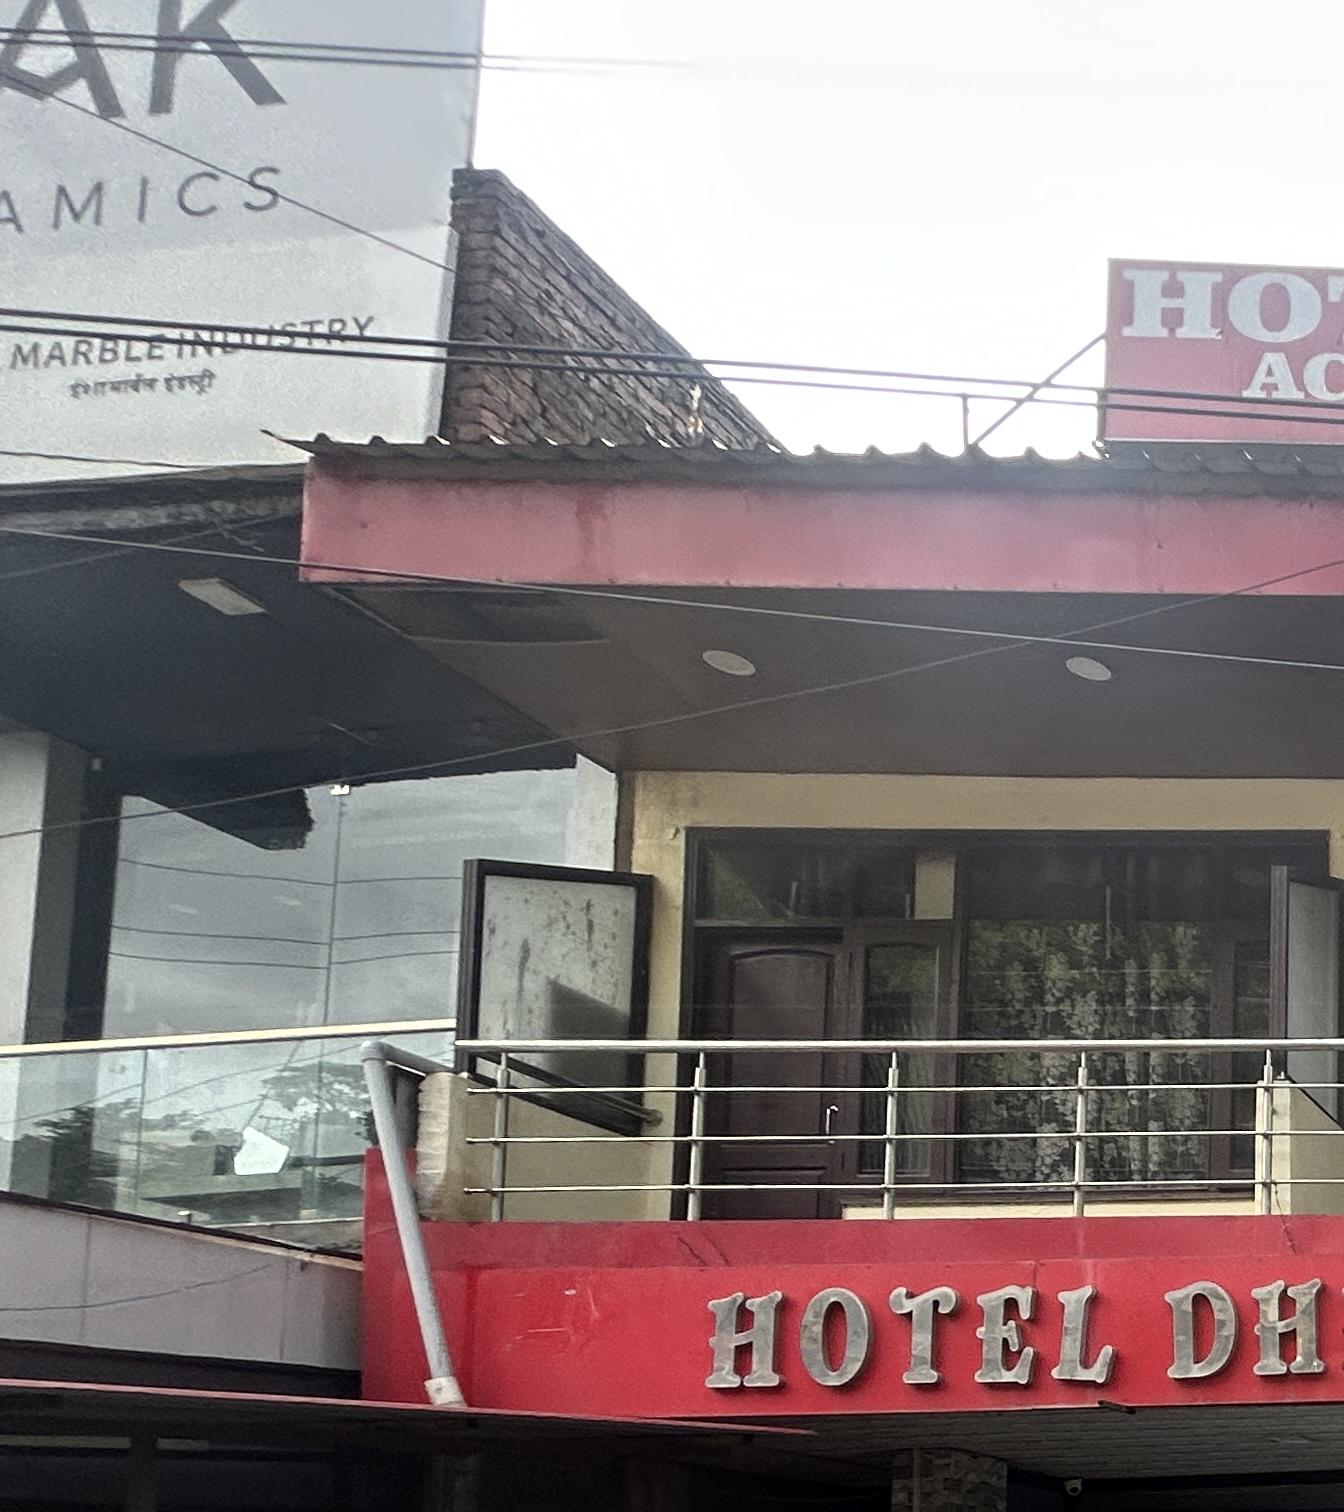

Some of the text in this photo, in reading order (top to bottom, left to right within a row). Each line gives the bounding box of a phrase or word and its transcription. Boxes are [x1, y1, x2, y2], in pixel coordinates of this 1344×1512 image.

[9, 315, 375, 370] MARBLE INDUSTRY
[703, 1284, 1118, 1389] HOTEL
